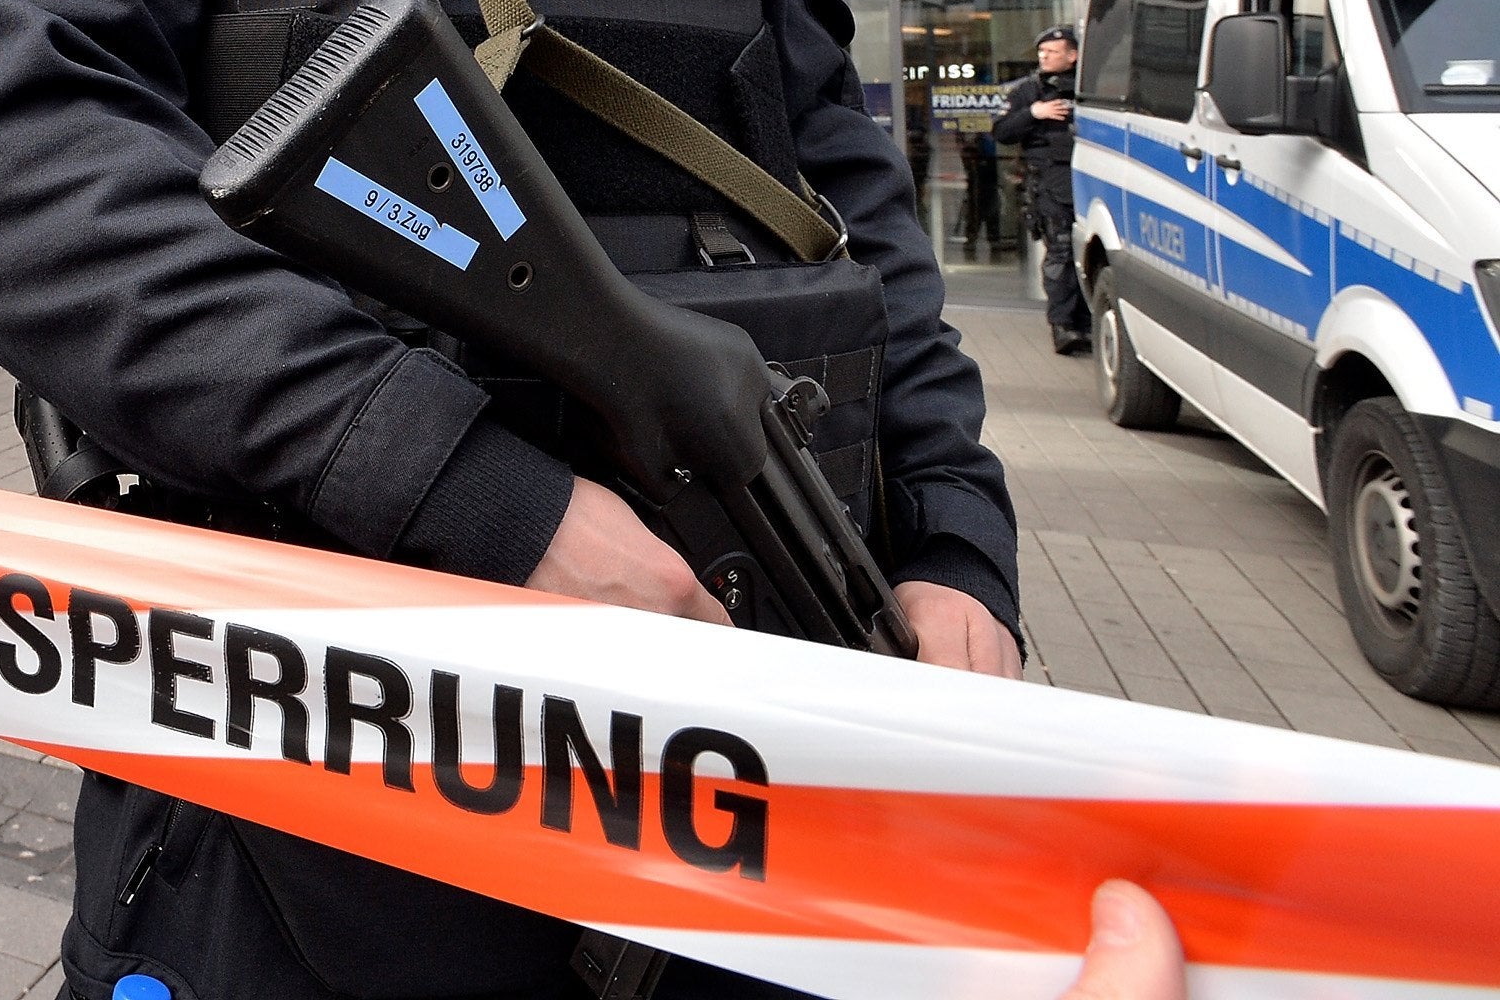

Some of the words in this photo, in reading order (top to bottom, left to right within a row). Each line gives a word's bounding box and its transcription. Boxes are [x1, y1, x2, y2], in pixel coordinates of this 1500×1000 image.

[931, 93, 1008, 109] FRIDAAA
[451, 132, 495, 193] 319738
[364, 190, 379, 207] 9
[387, 203, 432, 241] 3.Zug
[1139, 211, 1187, 263] POLIZEI
[727, 570, 738, 583] S
